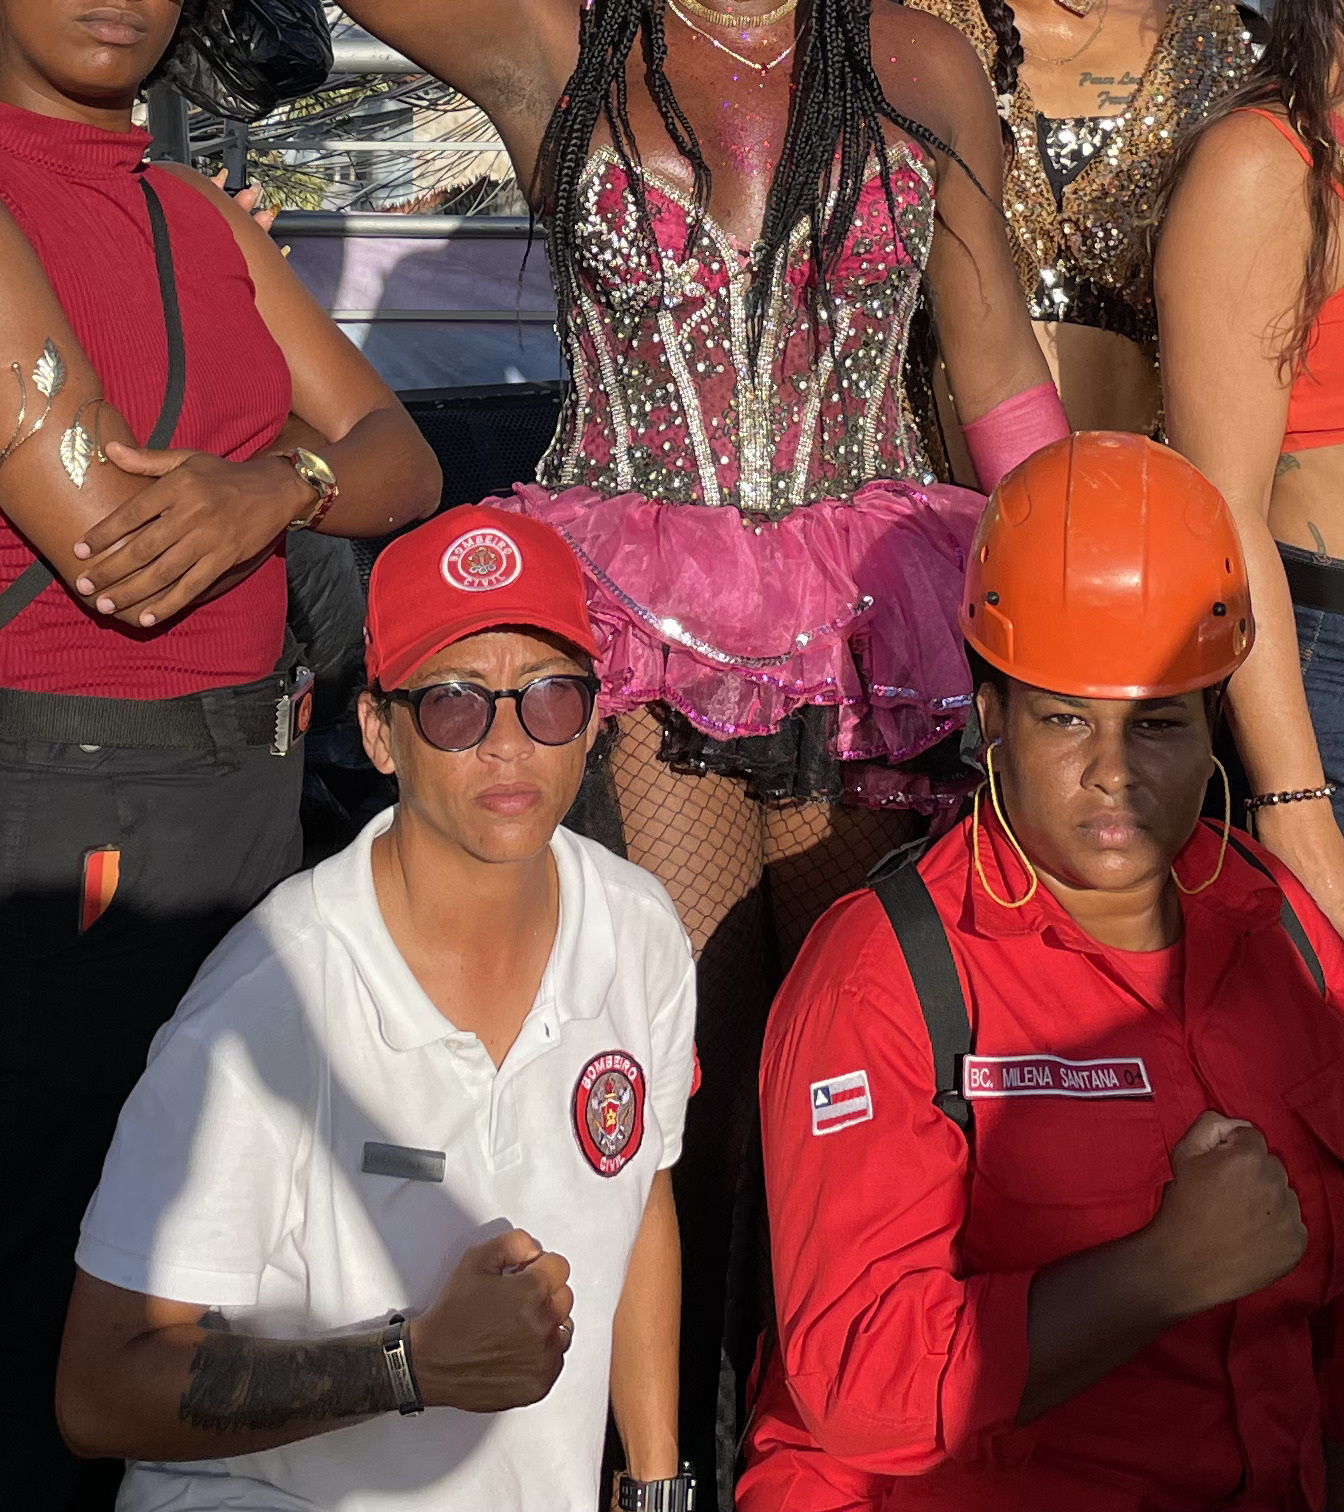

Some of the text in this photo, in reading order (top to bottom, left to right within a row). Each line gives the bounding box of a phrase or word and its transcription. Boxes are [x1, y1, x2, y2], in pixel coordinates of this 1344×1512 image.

[448, 534, 513, 562] BOMBEIRO
[463, 575, 506, 588] CIVIL
[581, 1055, 637, 1090] BOMBEIRO
[970, 1067, 994, 1088] BC.
[1002, 1066, 1053, 1088] MILENA
[1059, 1067, 1119, 1090] SANTANA
[599, 1154, 625, 1172] CIVIL
